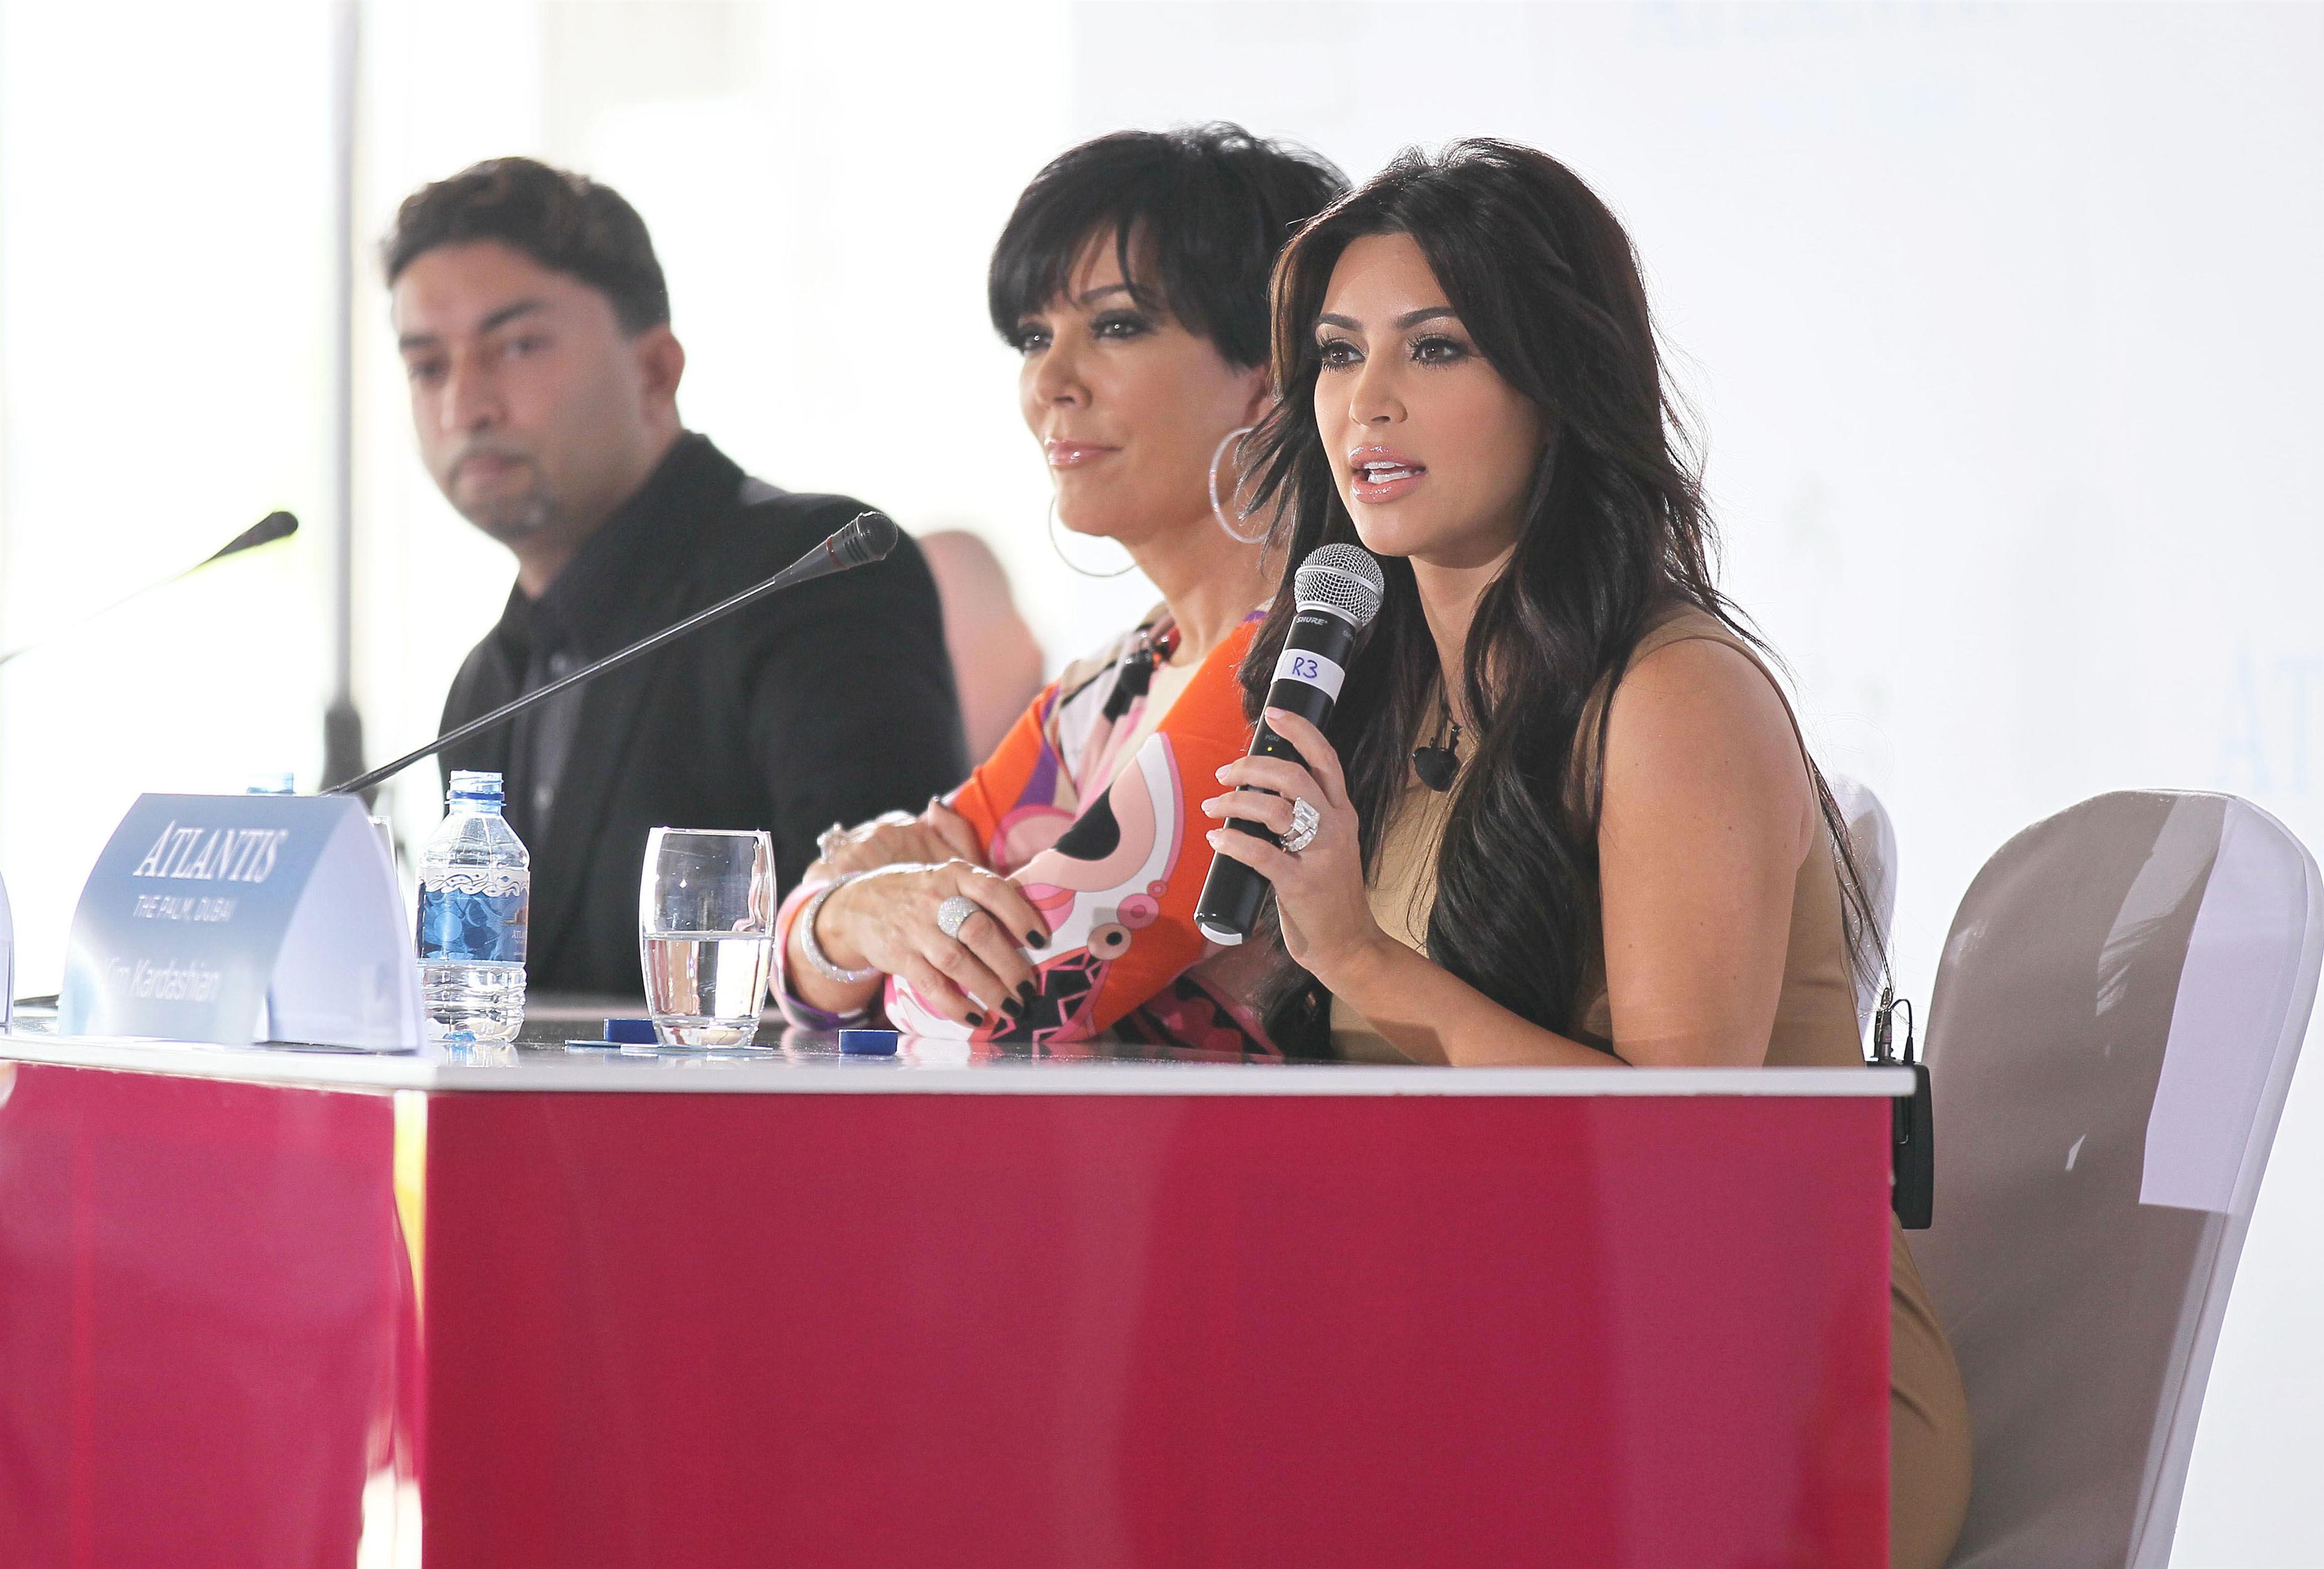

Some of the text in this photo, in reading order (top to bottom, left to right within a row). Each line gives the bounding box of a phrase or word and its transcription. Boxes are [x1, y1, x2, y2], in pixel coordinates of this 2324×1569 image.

[1296, 616, 1325, 625] SHURE
[1293, 657, 1318, 678] R3
[132, 820, 289, 884] ATLANTIS
[132, 894, 161, 919] THE
